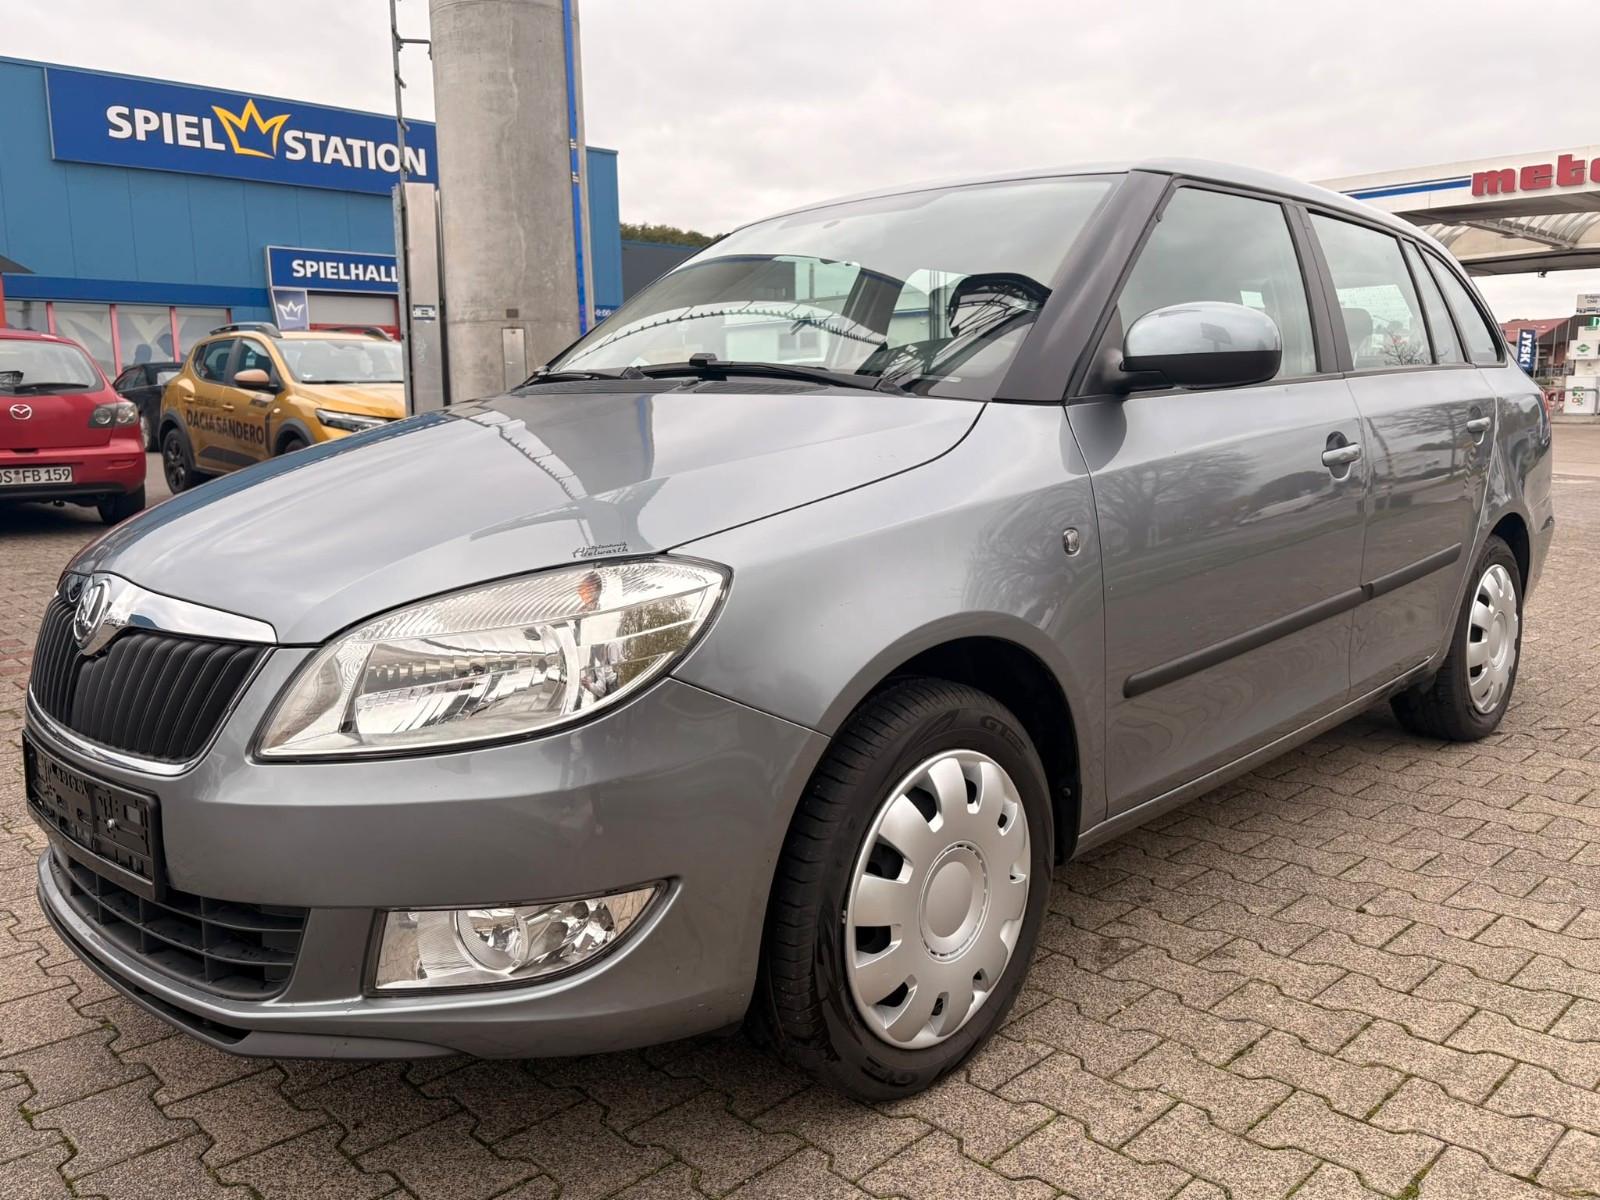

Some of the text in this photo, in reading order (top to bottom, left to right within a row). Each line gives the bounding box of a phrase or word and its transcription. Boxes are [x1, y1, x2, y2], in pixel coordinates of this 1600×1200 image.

[105, 105, 427, 177] SPIEL STATION
[1519, 331, 1533, 362] JYSK
[186, 409, 264, 444] DACIA SANDERO
[22, 469, 42, 482] FB
[44, 468, 71, 482] 159
